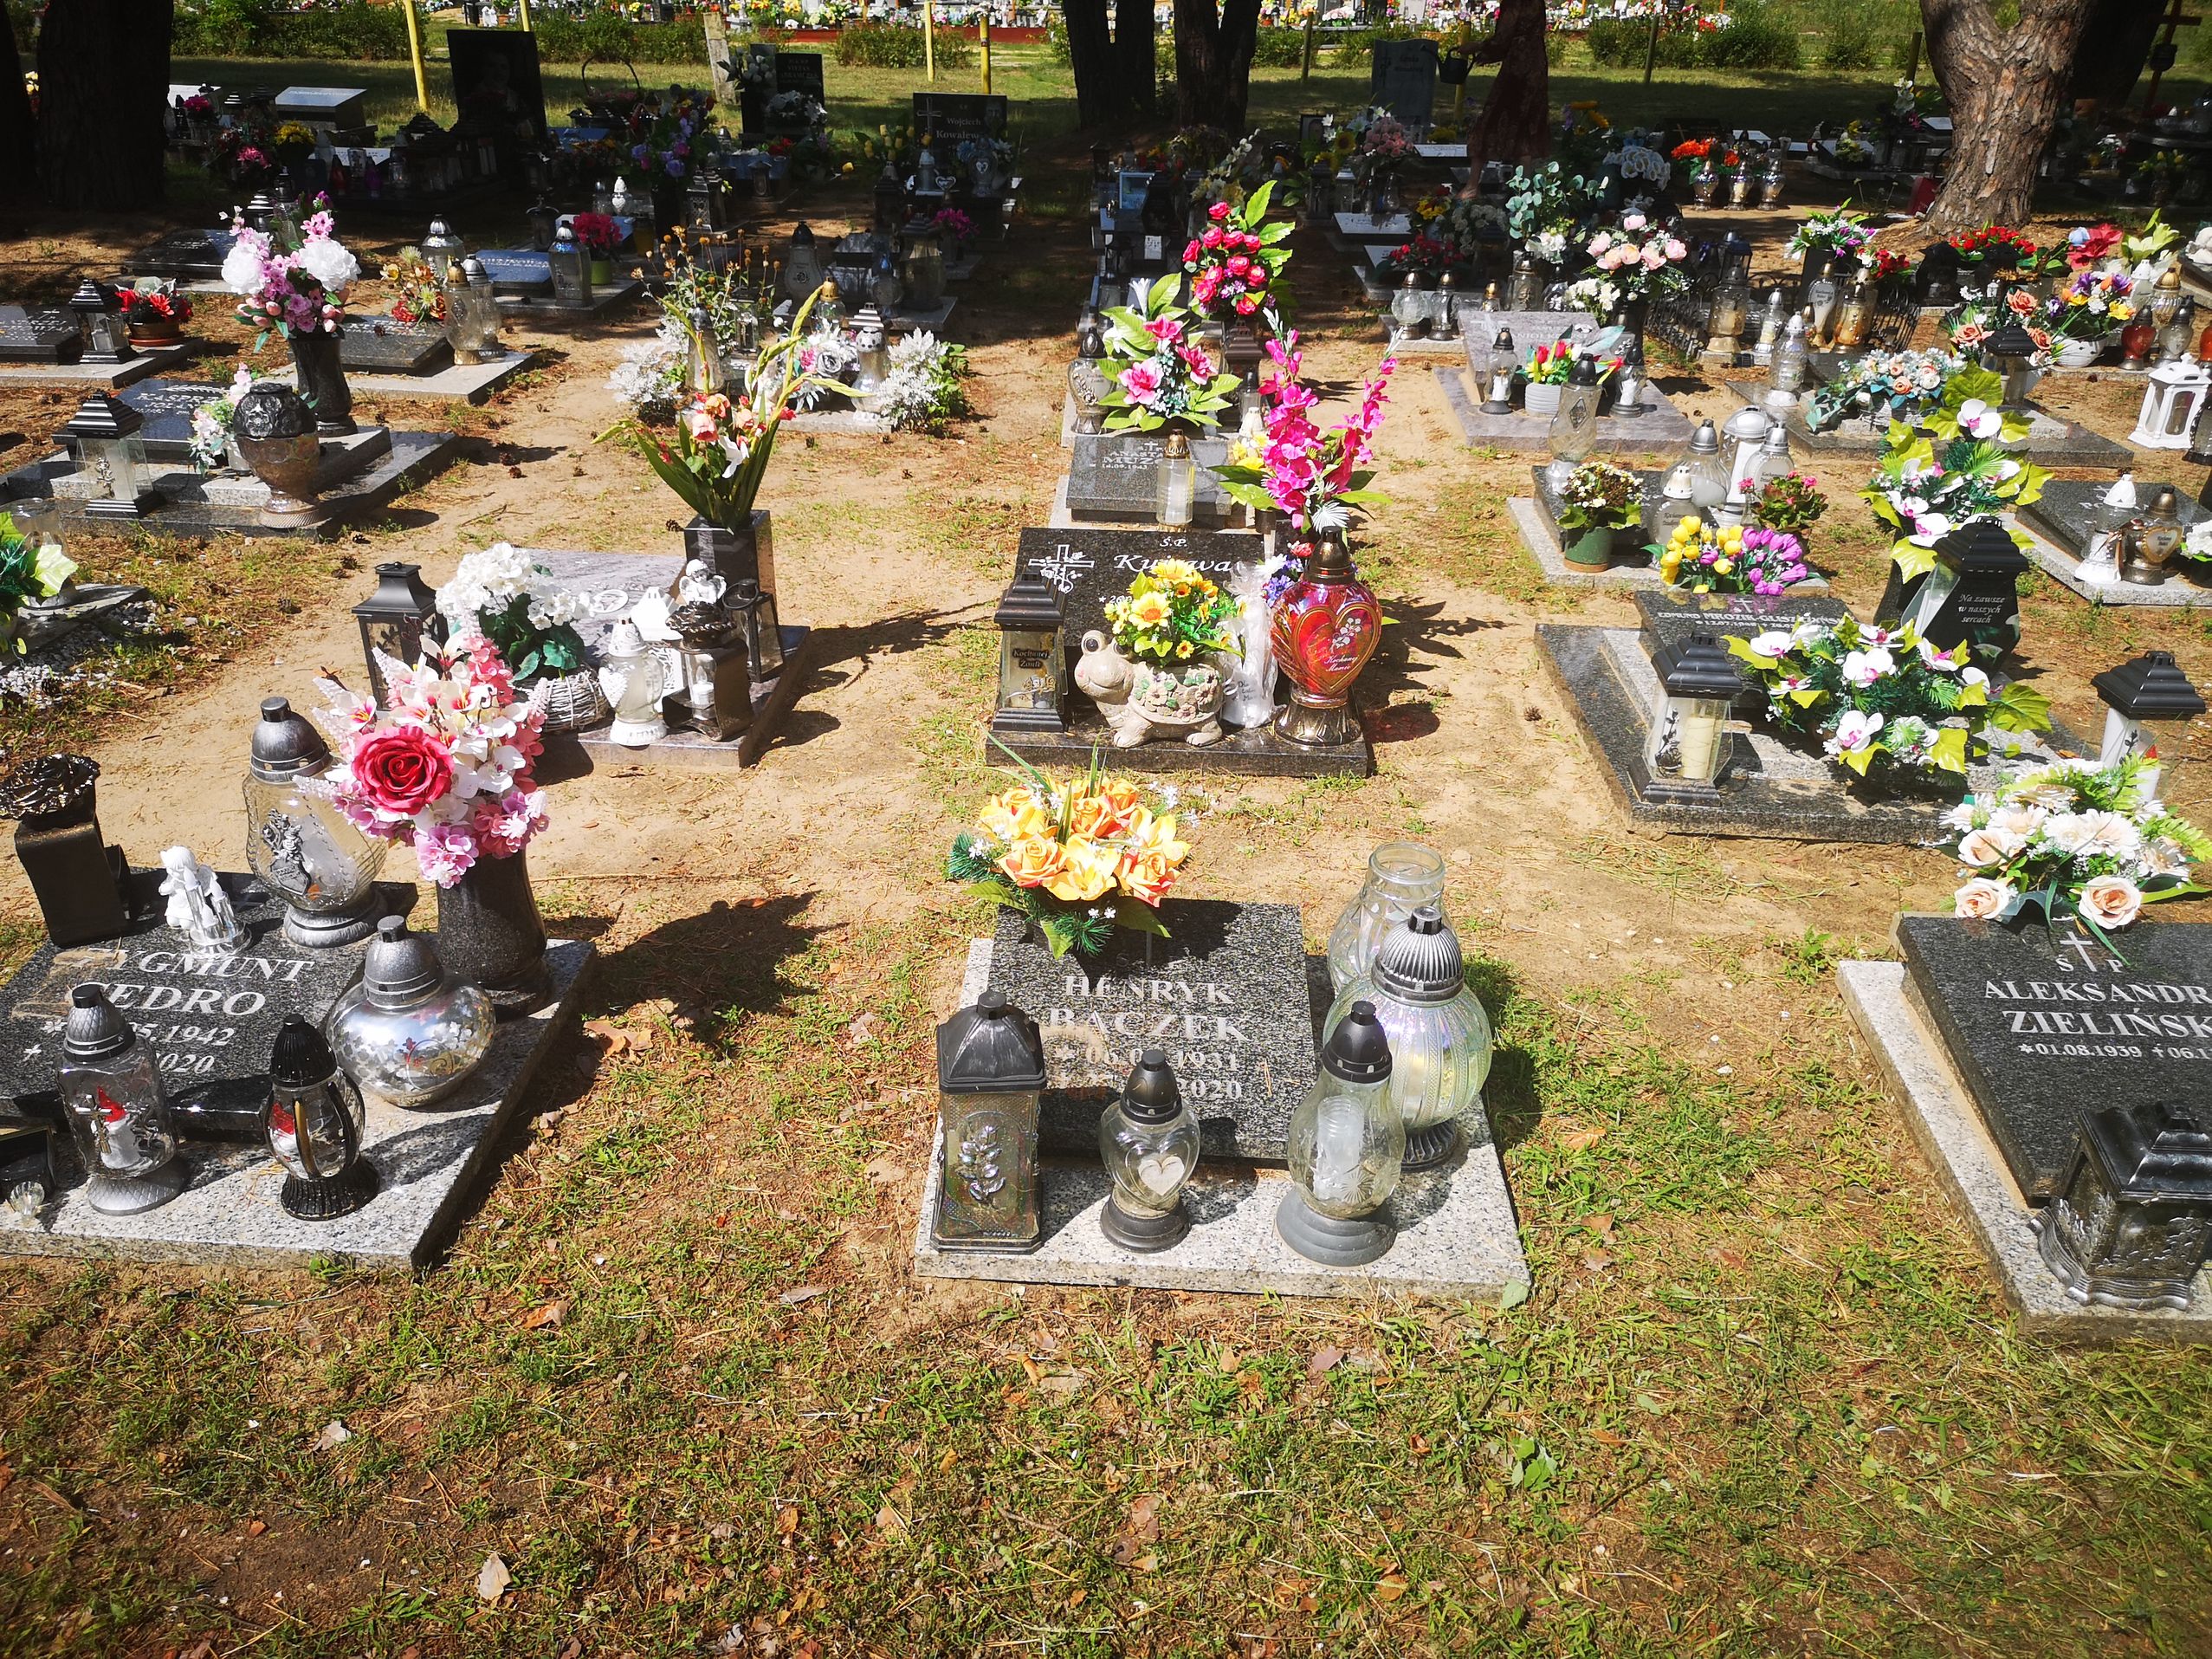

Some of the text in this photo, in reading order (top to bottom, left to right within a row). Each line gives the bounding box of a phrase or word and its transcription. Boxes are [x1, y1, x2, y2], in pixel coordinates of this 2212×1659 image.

[1957, 593, 1973, 603] Na
[1961, 614, 1993, 624] sercach
[1968, 604, 2002, 616] naszych
[68, 982, 266, 1016] EDRO
[1066, 975, 1235, 1005] HENRYK
[2002, 1007, 2212, 1038] ZIELIŃSK
